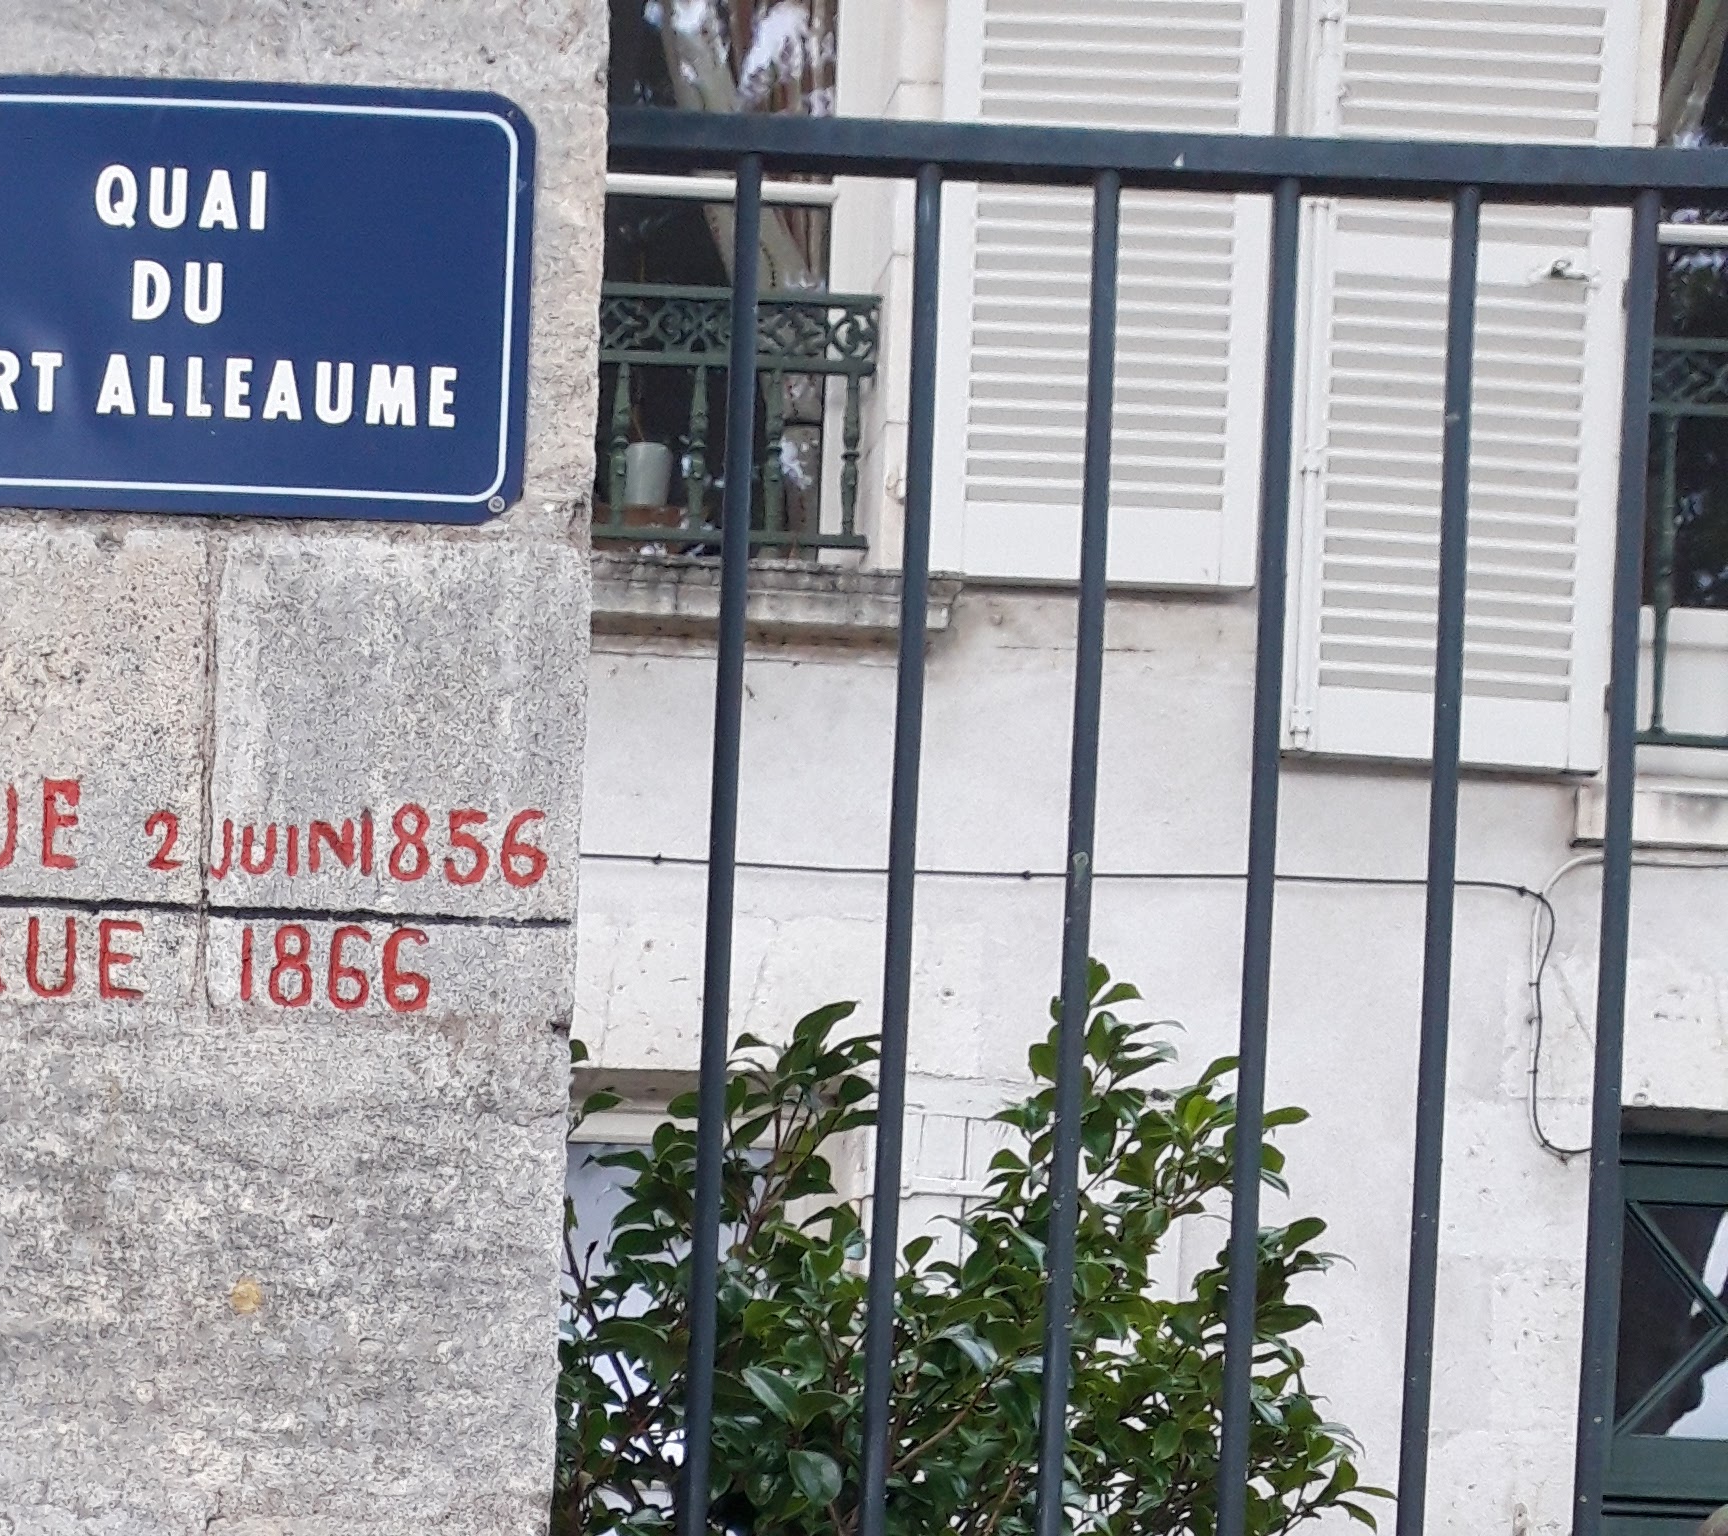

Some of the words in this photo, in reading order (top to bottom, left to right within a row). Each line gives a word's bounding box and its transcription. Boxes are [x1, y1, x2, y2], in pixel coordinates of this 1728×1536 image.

[94, 163, 268, 231] QUAI
[130, 258, 224, 326] DU
[95, 352, 458, 429] ALLEAUME
[143, 809, 183, 872] 2
[238, 922, 432, 1014] 1866
